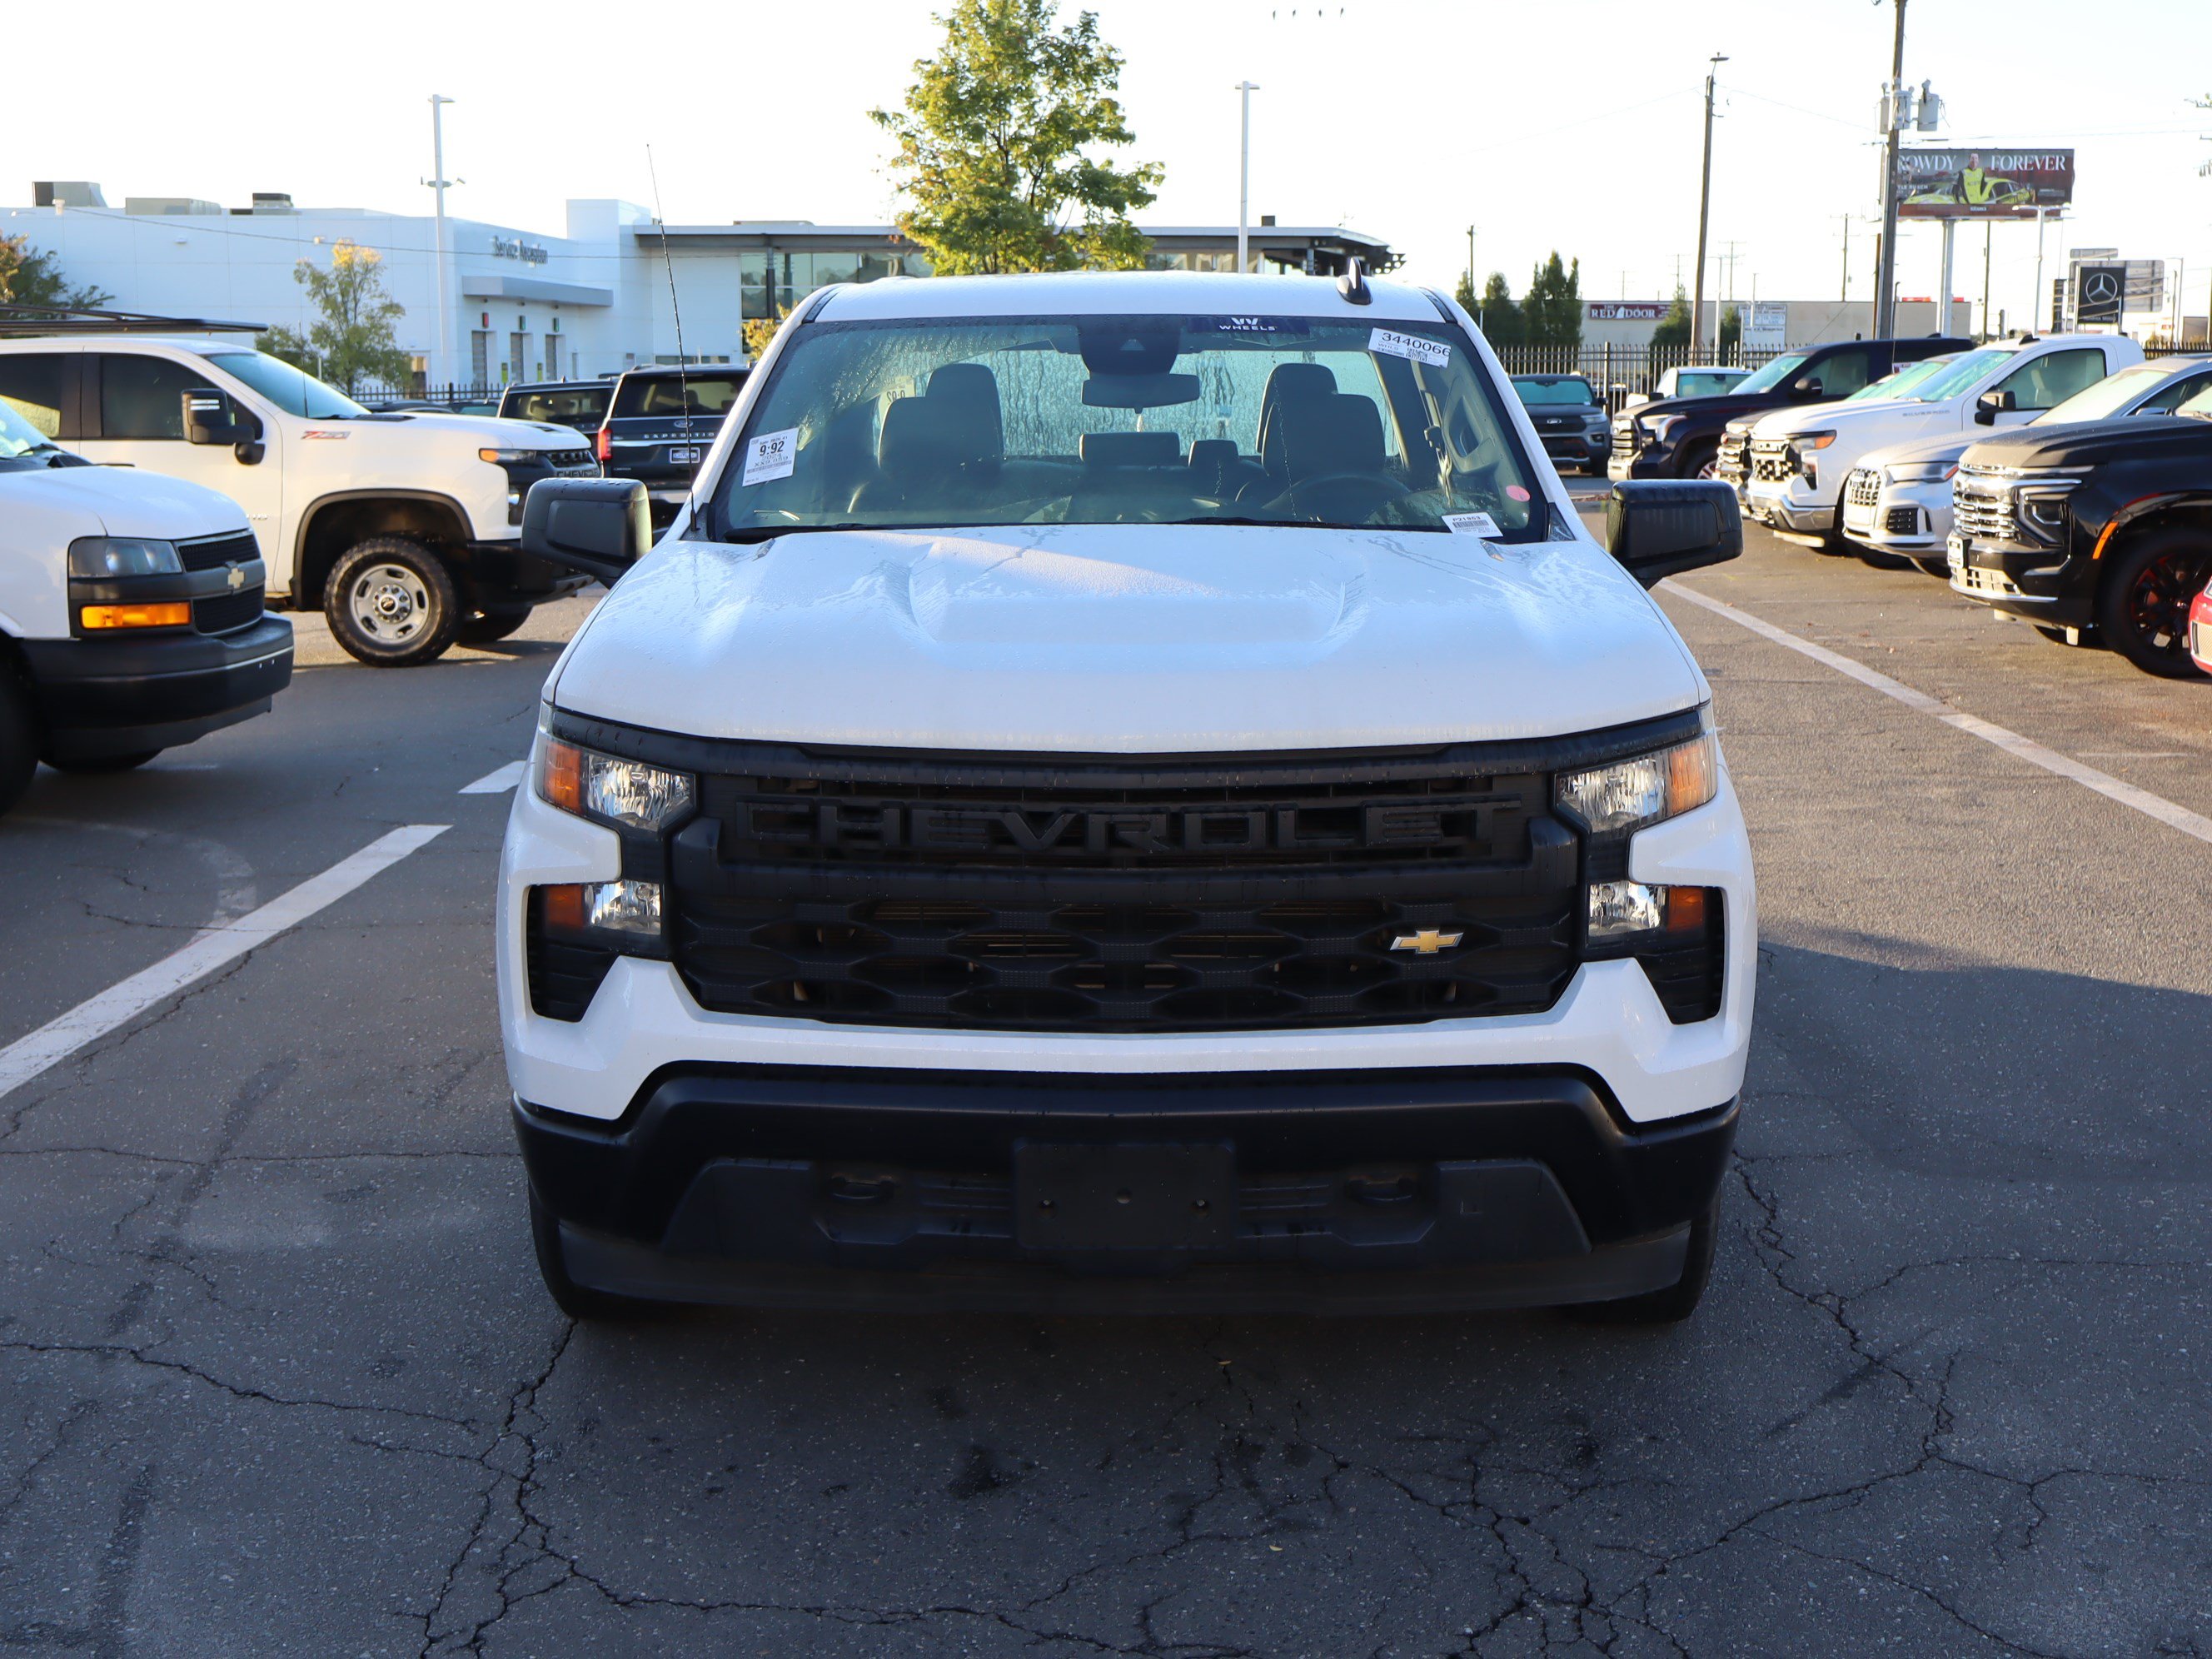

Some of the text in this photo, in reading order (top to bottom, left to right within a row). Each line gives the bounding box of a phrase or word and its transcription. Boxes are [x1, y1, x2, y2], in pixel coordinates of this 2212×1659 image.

[1990, 154, 2065, 171] FOREVER
[1592, 308, 1615, 318] RED
[1625, 308, 1656, 318] DOOR
[1382, 332, 1451, 356] 3440066
[736, 797, 1522, 851] CHEVROLET
